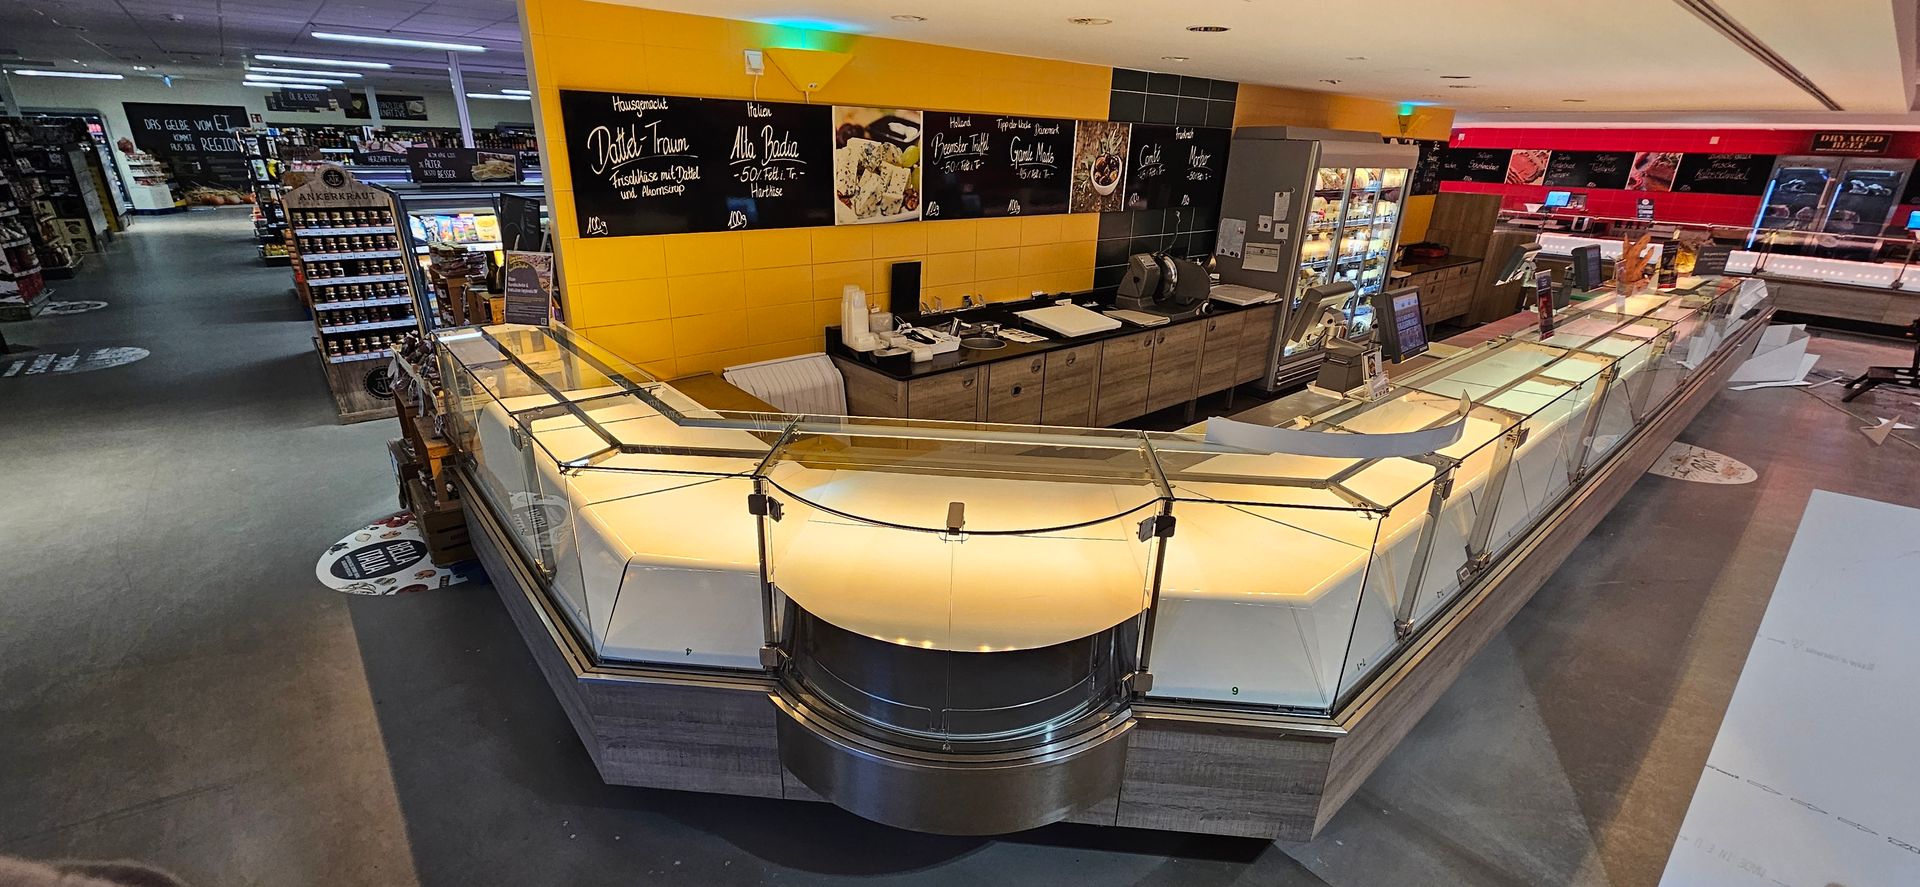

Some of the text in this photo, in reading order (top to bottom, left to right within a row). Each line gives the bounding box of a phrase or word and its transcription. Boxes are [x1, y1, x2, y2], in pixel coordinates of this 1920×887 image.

[612, 96, 668, 118] Hausgemacht
[747, 102, 772, 118] Italien
[144, 114, 230, 131] DAS GELBE VOM EI
[950, 116, 971, 128] Holland
[200, 138, 242, 152] REGION
[730, 124, 799, 166] Alta Badia
[1850, 135, 1884, 143] AGED
[609, 165, 700, 188] Frischkäse mit Dattel
[763, 166, 779, 180] Fett
[299, 192, 376, 200] ANKERKRAUT
[620, 187, 638, 200] und
[751, 182, 782, 198] Hartkäse
[587, 216, 608, 235] 100g
[728, 210, 747, 229] 100g
[356, 548, 390, 575] ITALIA
[386, 541, 420, 566] BELLA
